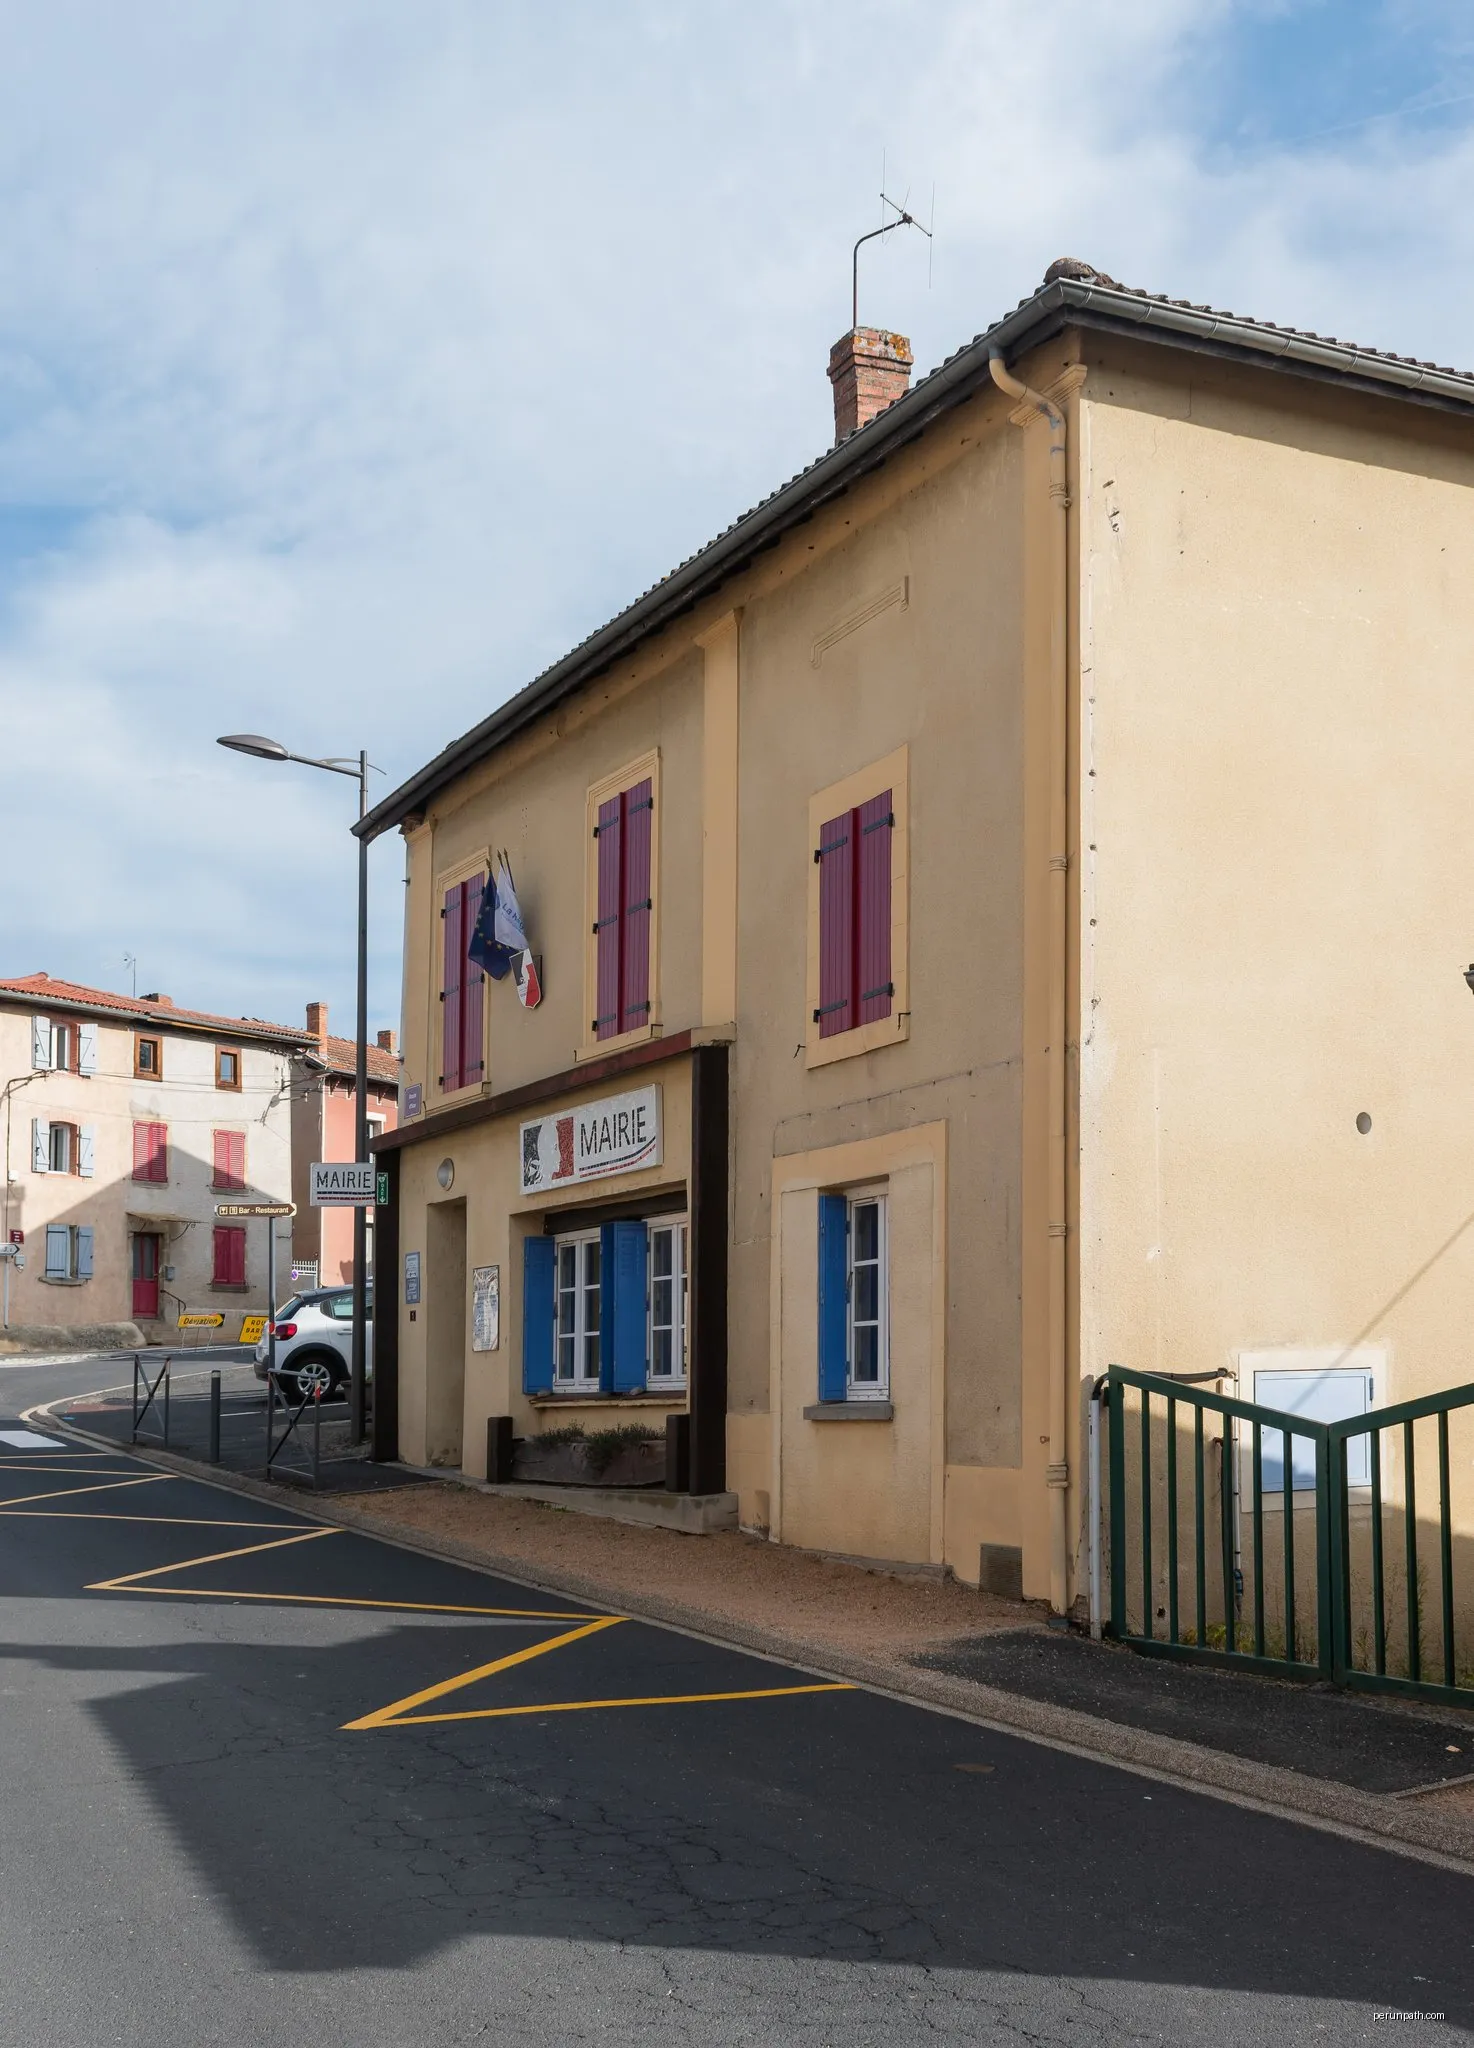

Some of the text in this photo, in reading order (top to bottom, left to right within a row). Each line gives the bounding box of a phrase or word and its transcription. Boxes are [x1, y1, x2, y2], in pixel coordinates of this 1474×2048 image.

[580, 1105, 647, 1157] MAIRIE
[316, 1171, 372, 1189] MAIRIE
[238, 1206, 251, 1214] Bar
[255, 1206, 289, 1214] Restaurant
[183, 1317, 218, 1325] Déviation
